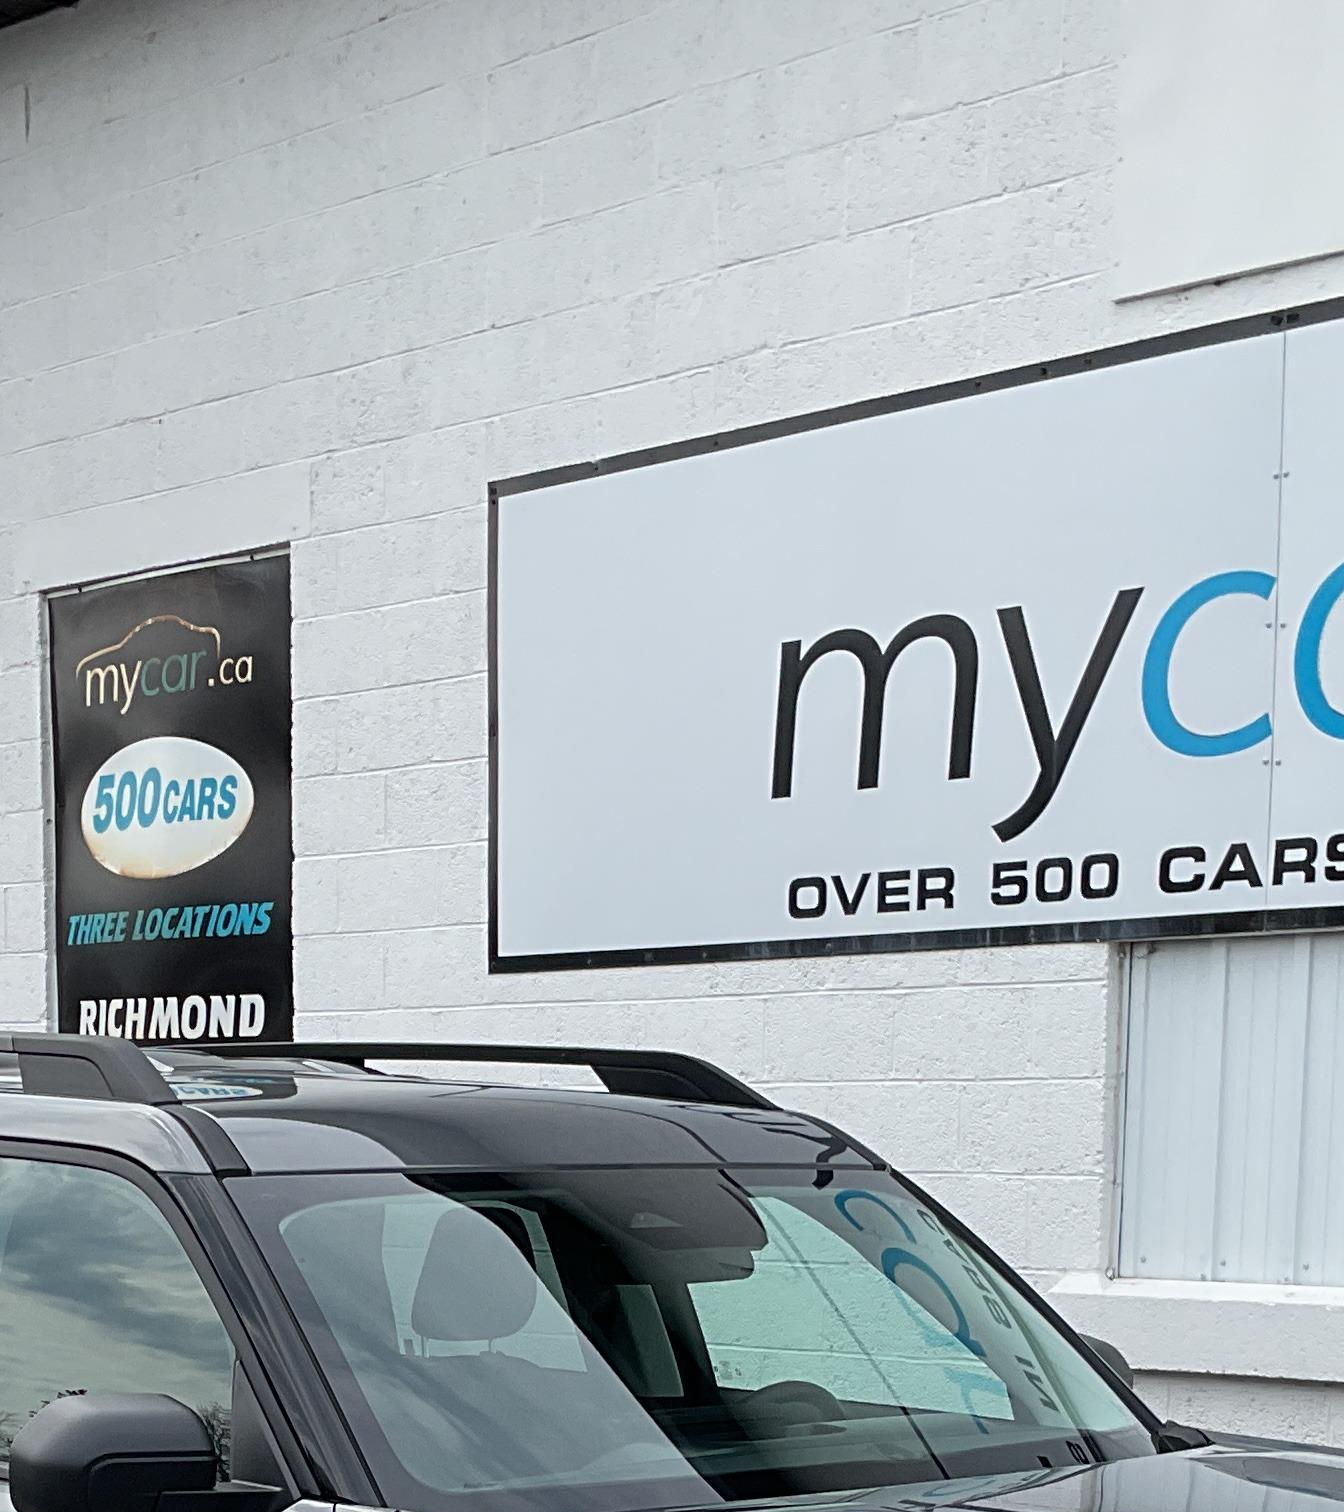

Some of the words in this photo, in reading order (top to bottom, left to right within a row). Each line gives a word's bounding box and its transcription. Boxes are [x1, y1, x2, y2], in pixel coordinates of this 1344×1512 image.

[85, 650, 254, 716] mycar.ca
[788, 867, 956, 920] OVER
[990, 852, 1120, 906] 500
[67, 911, 130, 946] THREE
[131, 901, 275, 942] LOCATIONS
[79, 993, 266, 1040] RICHMOND
